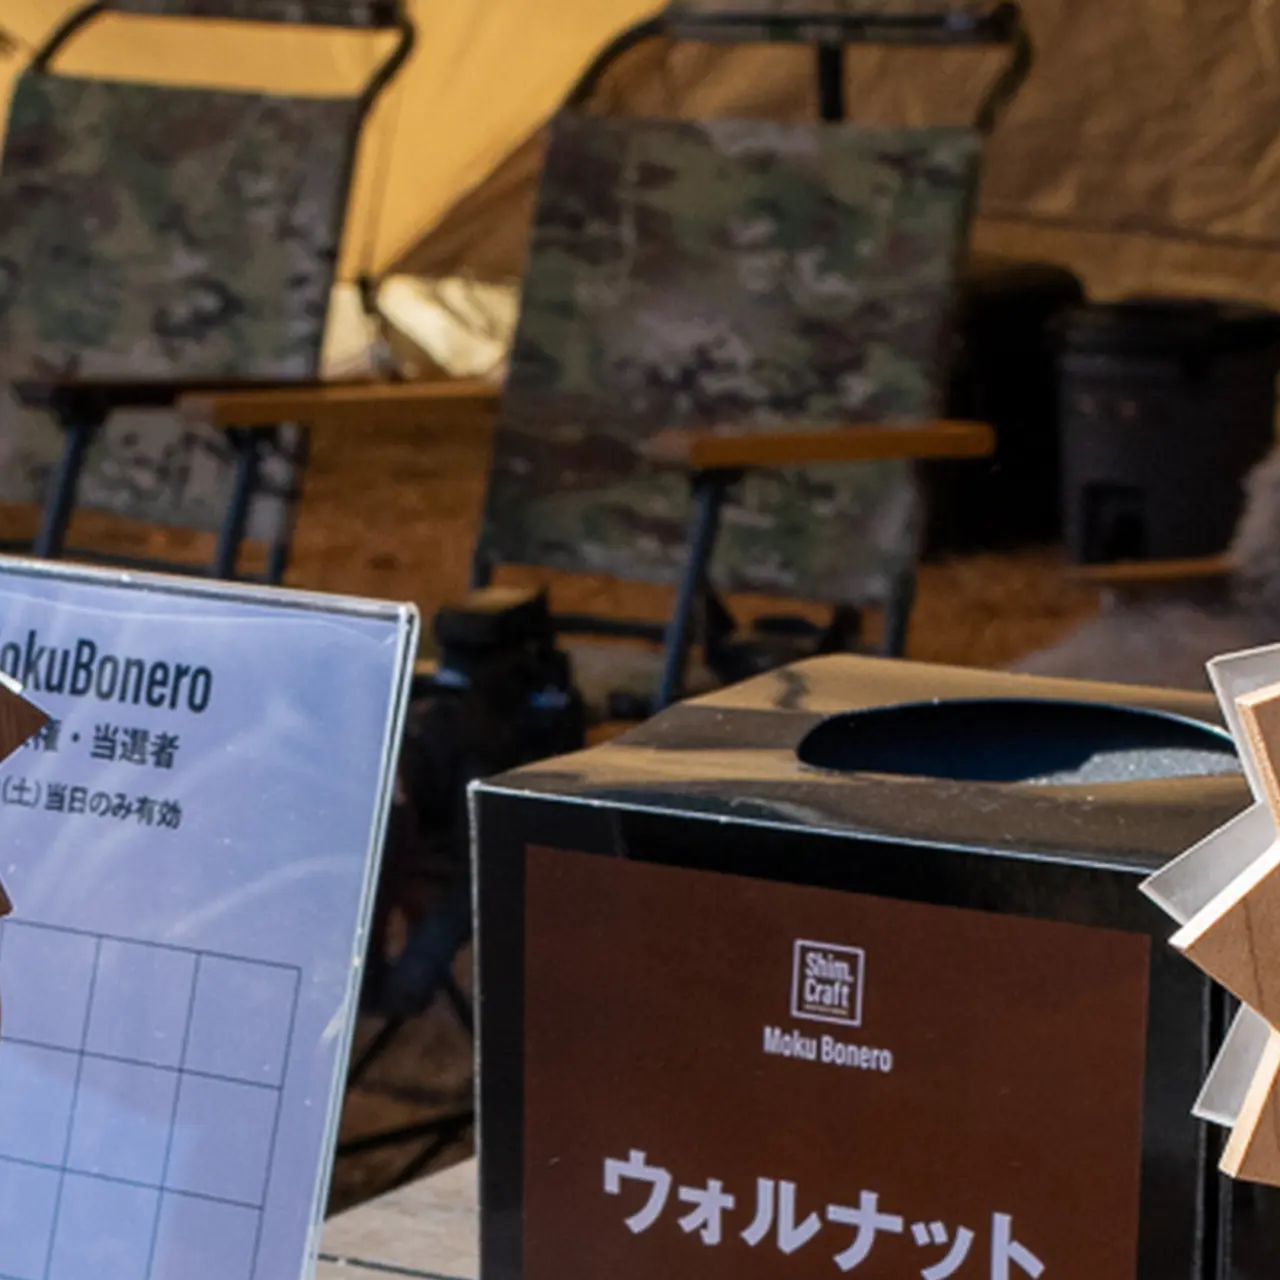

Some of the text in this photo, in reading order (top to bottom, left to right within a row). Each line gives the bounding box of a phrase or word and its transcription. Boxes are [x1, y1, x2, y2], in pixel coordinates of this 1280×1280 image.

[803, 978, 851, 1008] Craft
[762, 1024, 894, 1073] Moku Bonero
